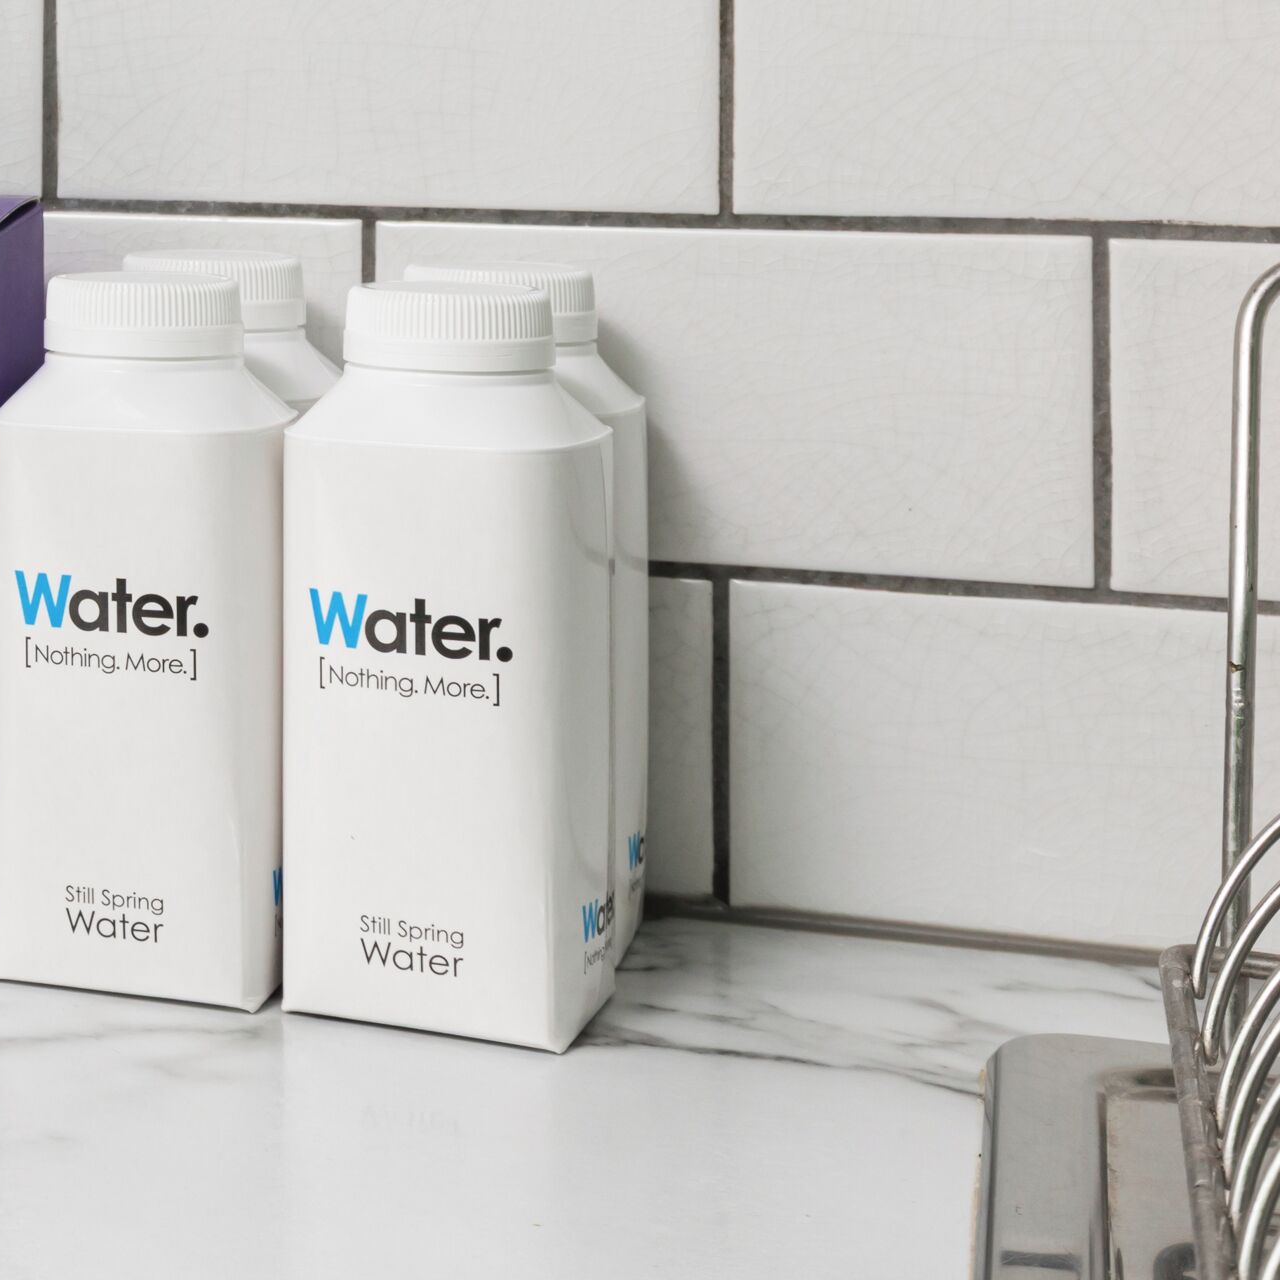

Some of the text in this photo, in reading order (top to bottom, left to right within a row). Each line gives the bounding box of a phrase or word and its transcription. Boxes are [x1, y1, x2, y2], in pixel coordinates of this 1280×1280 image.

[14, 569, 210, 639] Water.
[308, 587, 514, 663] Water.
[65, 884, 164, 916] Still Spring
[65, 907, 165, 944] Water
[359, 914, 464, 950] Still Spring
[360, 937, 464, 978] Water
